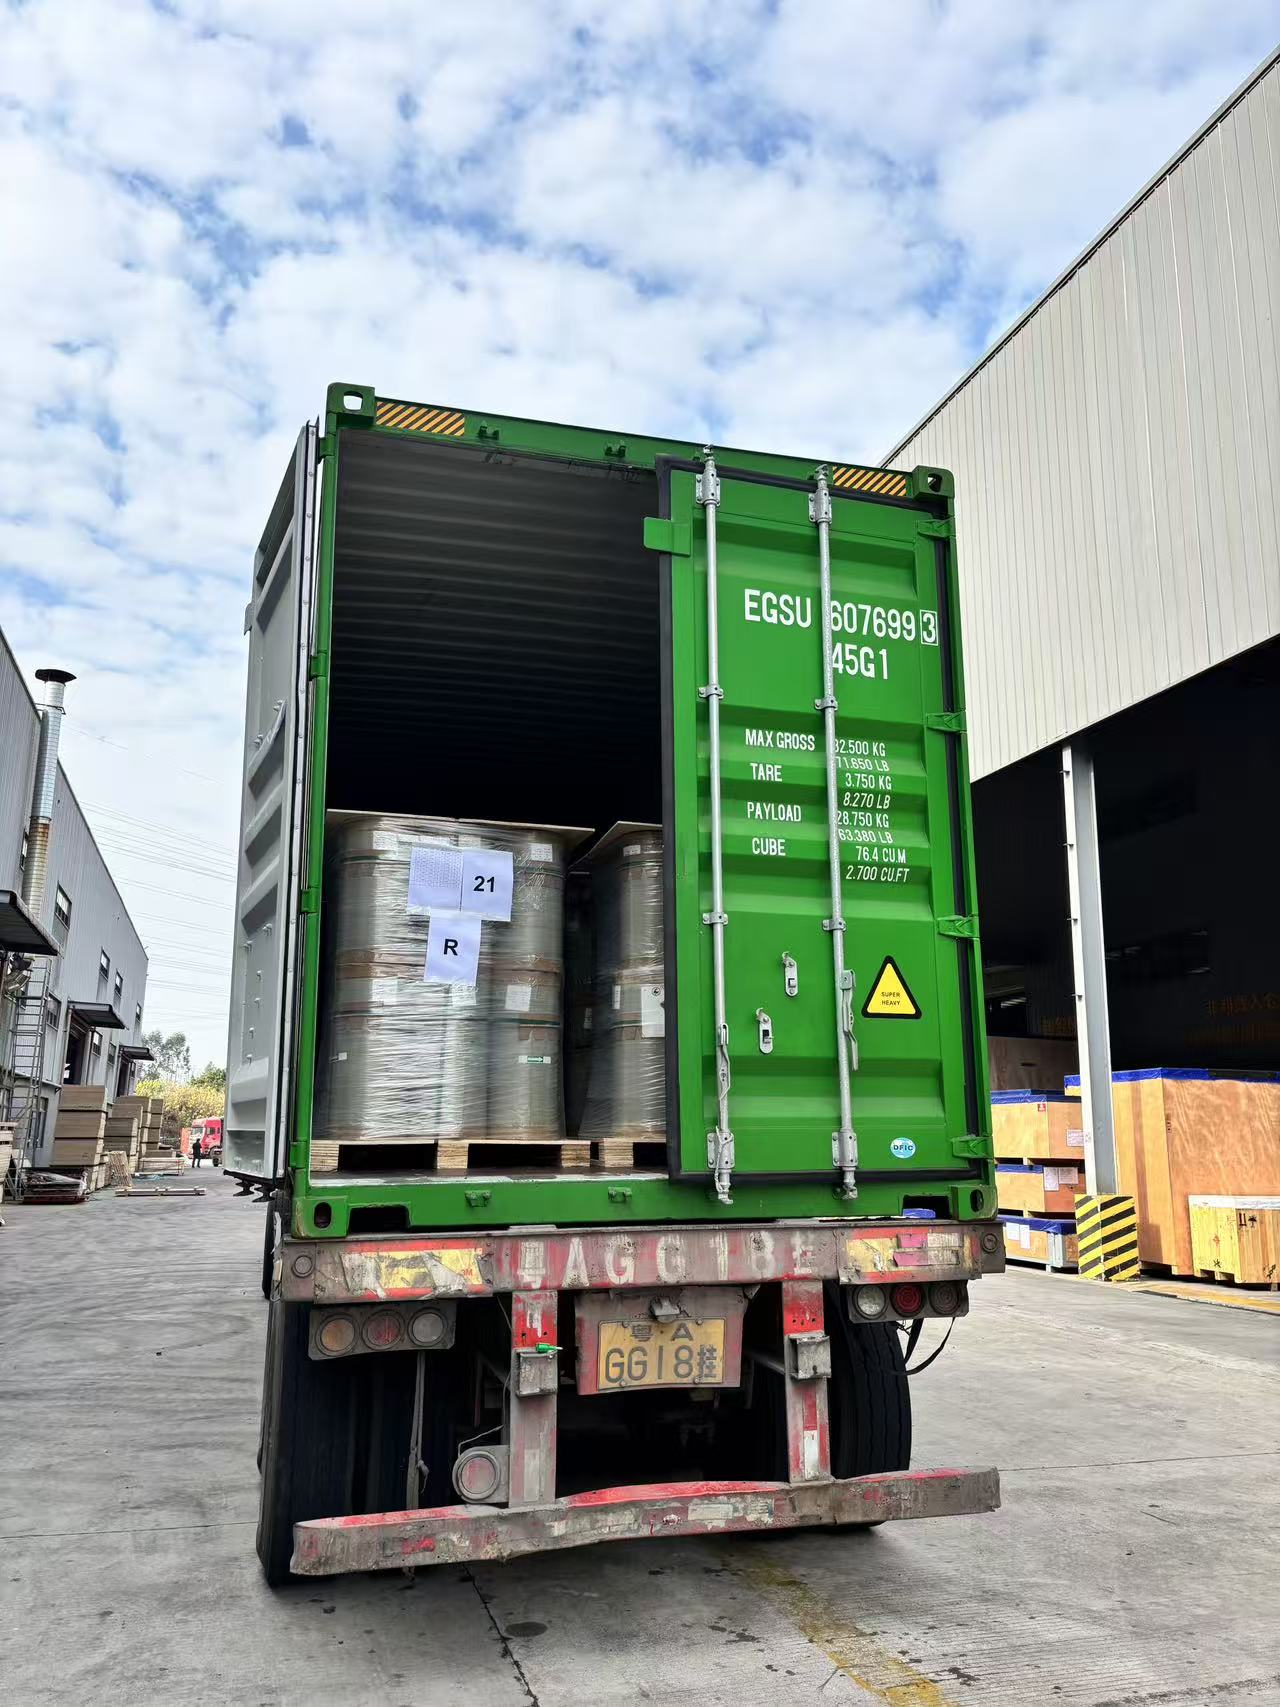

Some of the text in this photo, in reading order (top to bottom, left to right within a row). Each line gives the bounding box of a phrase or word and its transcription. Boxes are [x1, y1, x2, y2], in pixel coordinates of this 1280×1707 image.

[744, 588, 936, 643] EGSU 607699 3
[832, 642, 888, 680] 45G1
[745, 728, 774, 748] MAX
[777, 732, 815, 751] GROSS
[873, 742, 886, 757] KG
[750, 763, 892, 790] TARE 3.750 KG
[875, 759, 890, 772] LB
[843, 791, 891, 810] 8.270 LB
[747, 802, 802, 822] PAYLOAD
[876, 814, 889, 829] KG
[838, 829, 893, 844] 63.380 LB
[752, 838, 907, 864] CUBE 76.4 CU.M
[473, 875, 495, 893] 21
[846, 865, 910, 883] 2.700 CU.FT
[443, 938, 459, 956] R
